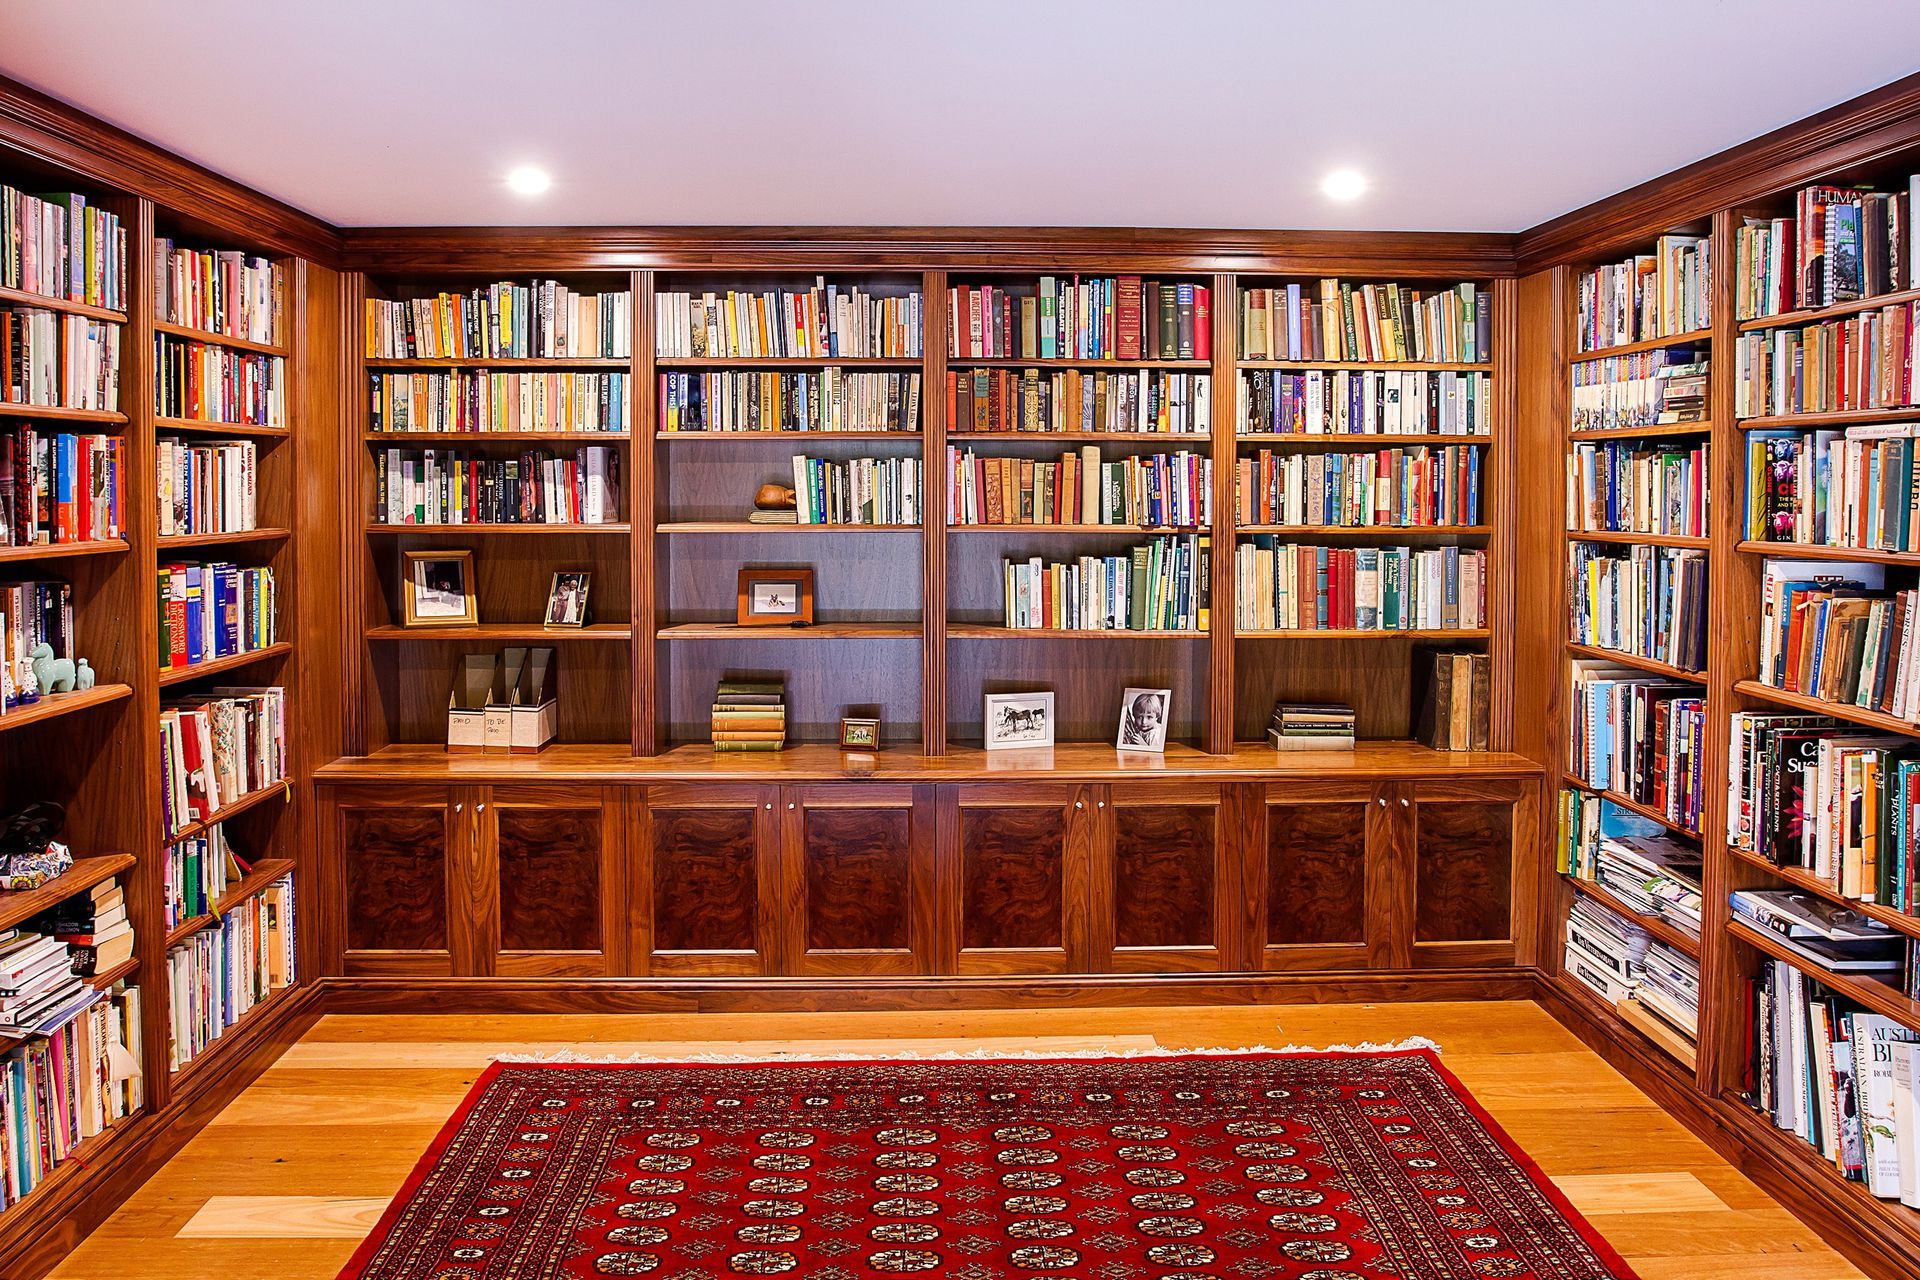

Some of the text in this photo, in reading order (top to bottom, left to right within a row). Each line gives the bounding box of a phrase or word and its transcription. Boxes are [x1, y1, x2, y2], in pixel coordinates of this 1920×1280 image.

[971, 296, 981, 322] ARCHER
[1058, 296, 1066, 333] DELEGATE
[1390, 297, 1400, 332] Innocent Killers
[669, 374, 677, 409] COP THIS!
[1107, 559, 1115, 578] ELMORE
[1107, 578, 1115, 599] LEONARD
[170, 604, 178, 655] DICTIONARY
[177, 603, 185, 654] CROSSWORD
[1901, 603, 1912, 647] HORSES
[1890, 798, 1898, 835] PLANTS
[1830, 849, 1839, 880] TREES
[1857, 1025, 1867, 1087] AUSTRALIAN
